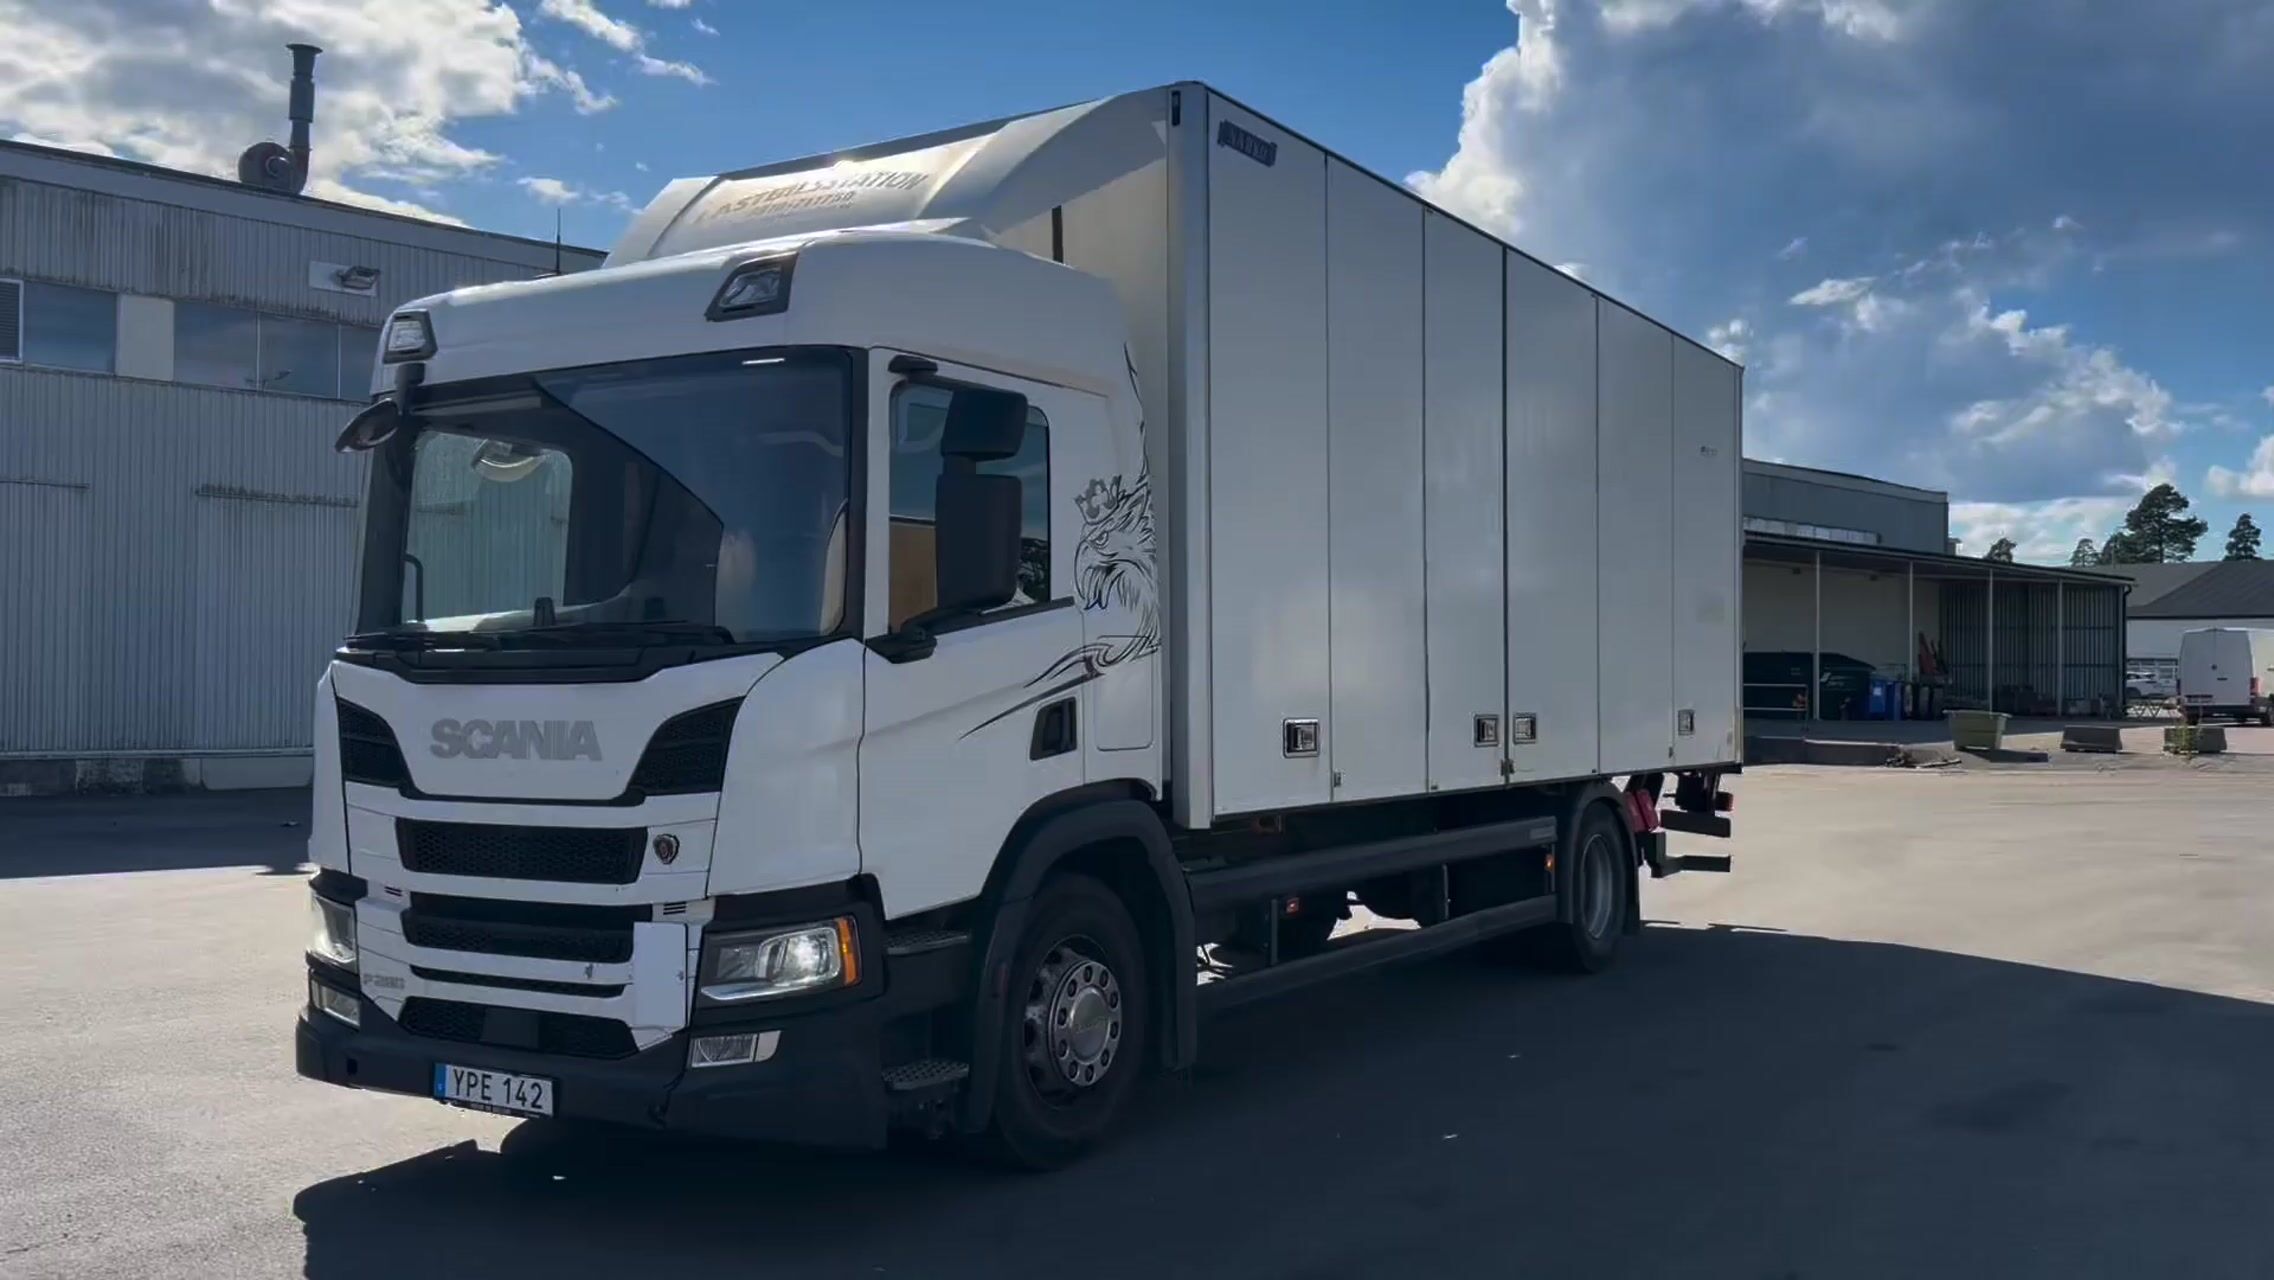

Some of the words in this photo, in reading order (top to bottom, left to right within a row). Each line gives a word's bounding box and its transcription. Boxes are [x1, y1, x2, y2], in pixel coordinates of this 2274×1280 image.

[429, 718, 603, 761] SCANIA
[453, 1068, 493, 1101] YPE
[503, 1078, 543, 1110] 142
